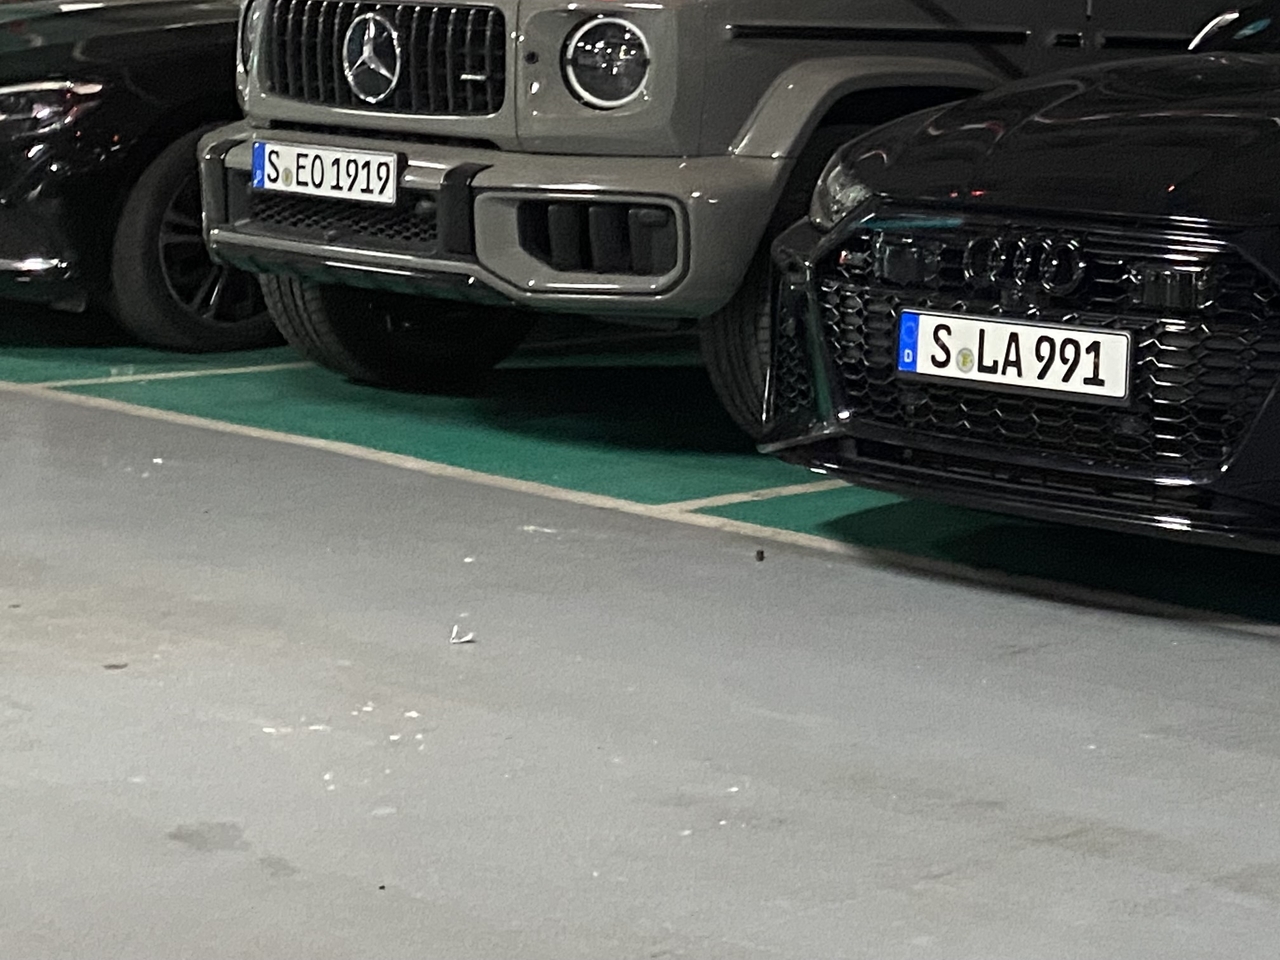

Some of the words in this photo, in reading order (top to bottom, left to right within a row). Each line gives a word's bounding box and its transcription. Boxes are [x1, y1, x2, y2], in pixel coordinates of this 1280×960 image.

[267, 150, 280, 183] S
[296, 152, 325, 189] EO
[330, 157, 391, 195] 1919
[903, 349, 913, 363] D
[930, 323, 952, 368] S
[977, 328, 1023, 377] LA
[1035, 335, 1106, 387] 991
